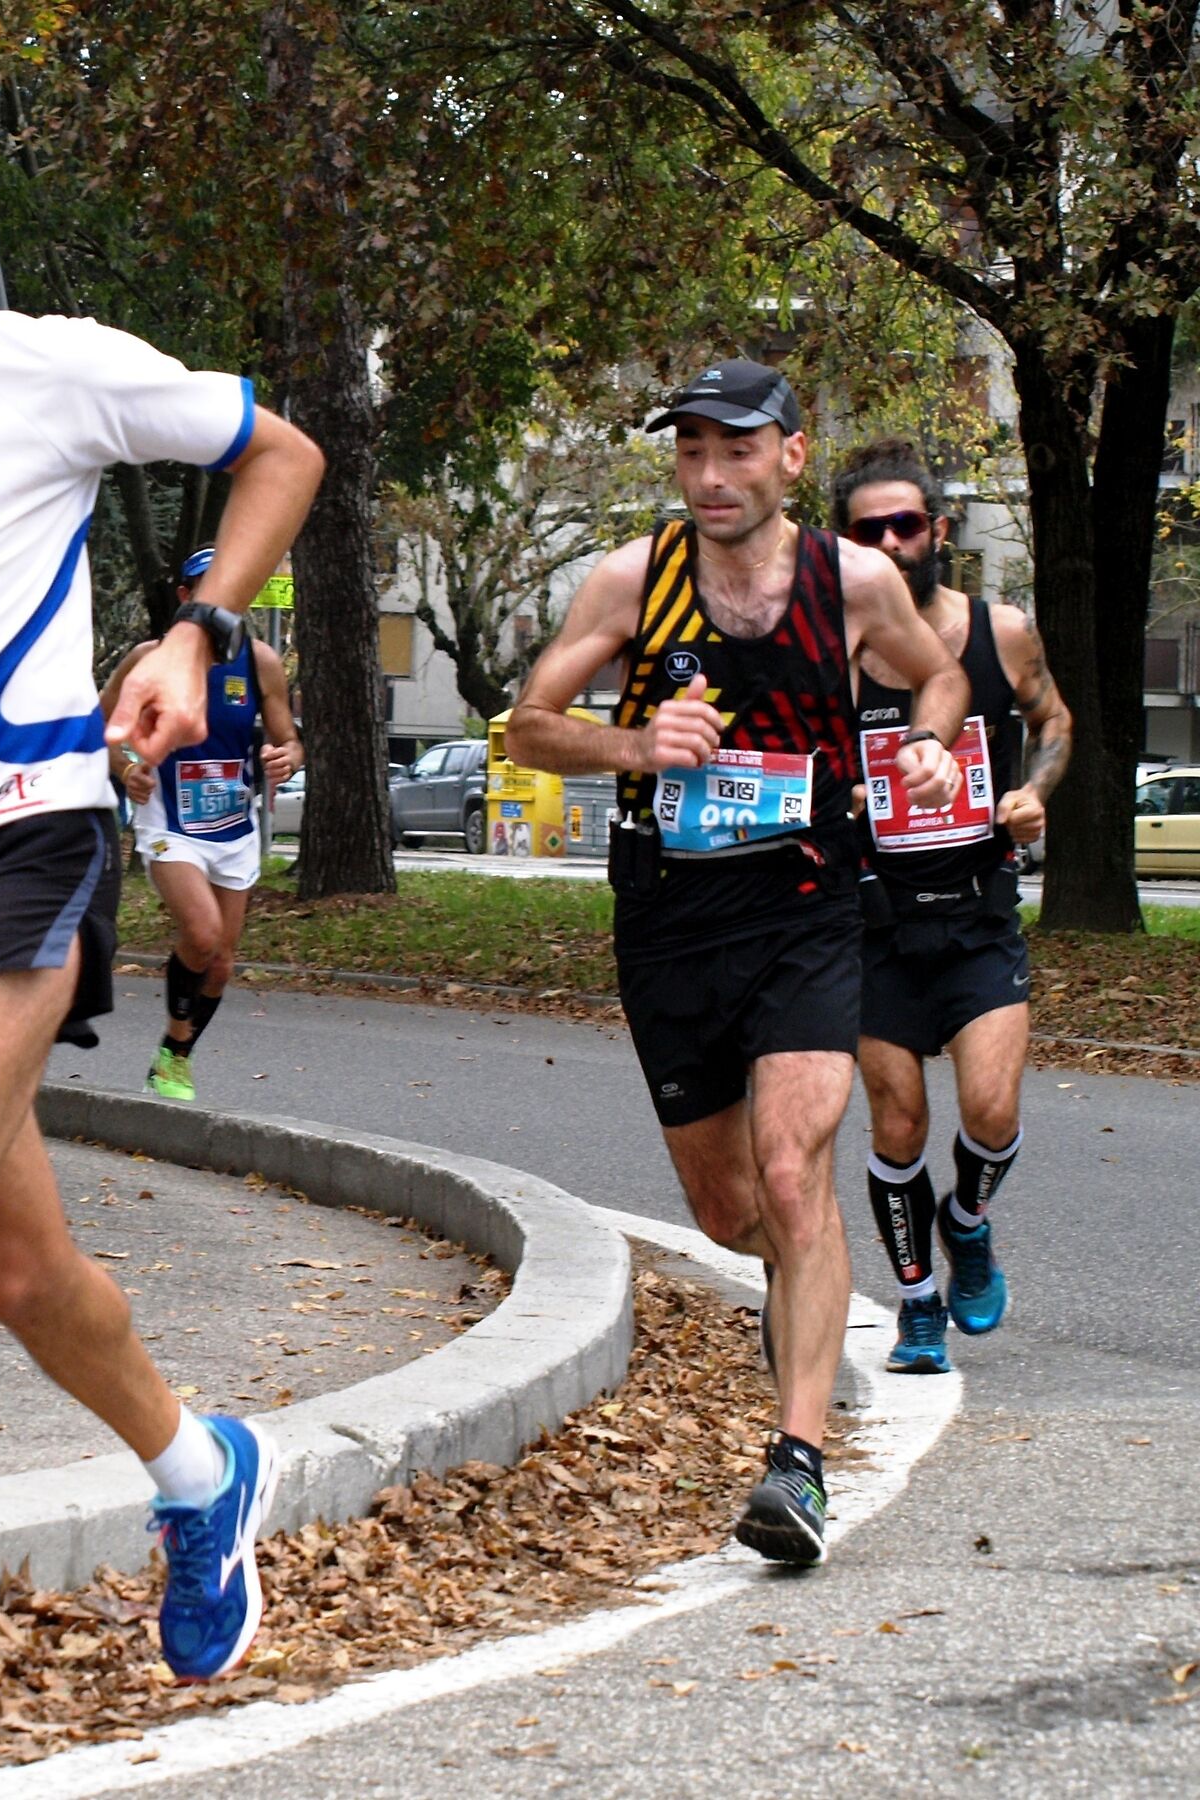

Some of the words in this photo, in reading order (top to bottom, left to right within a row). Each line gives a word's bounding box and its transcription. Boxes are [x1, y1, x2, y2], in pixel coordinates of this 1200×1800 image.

[198, 795, 231, 813] 1511
[908, 816, 944, 829] ANDREA
[709, 832, 736, 847] ERIC
